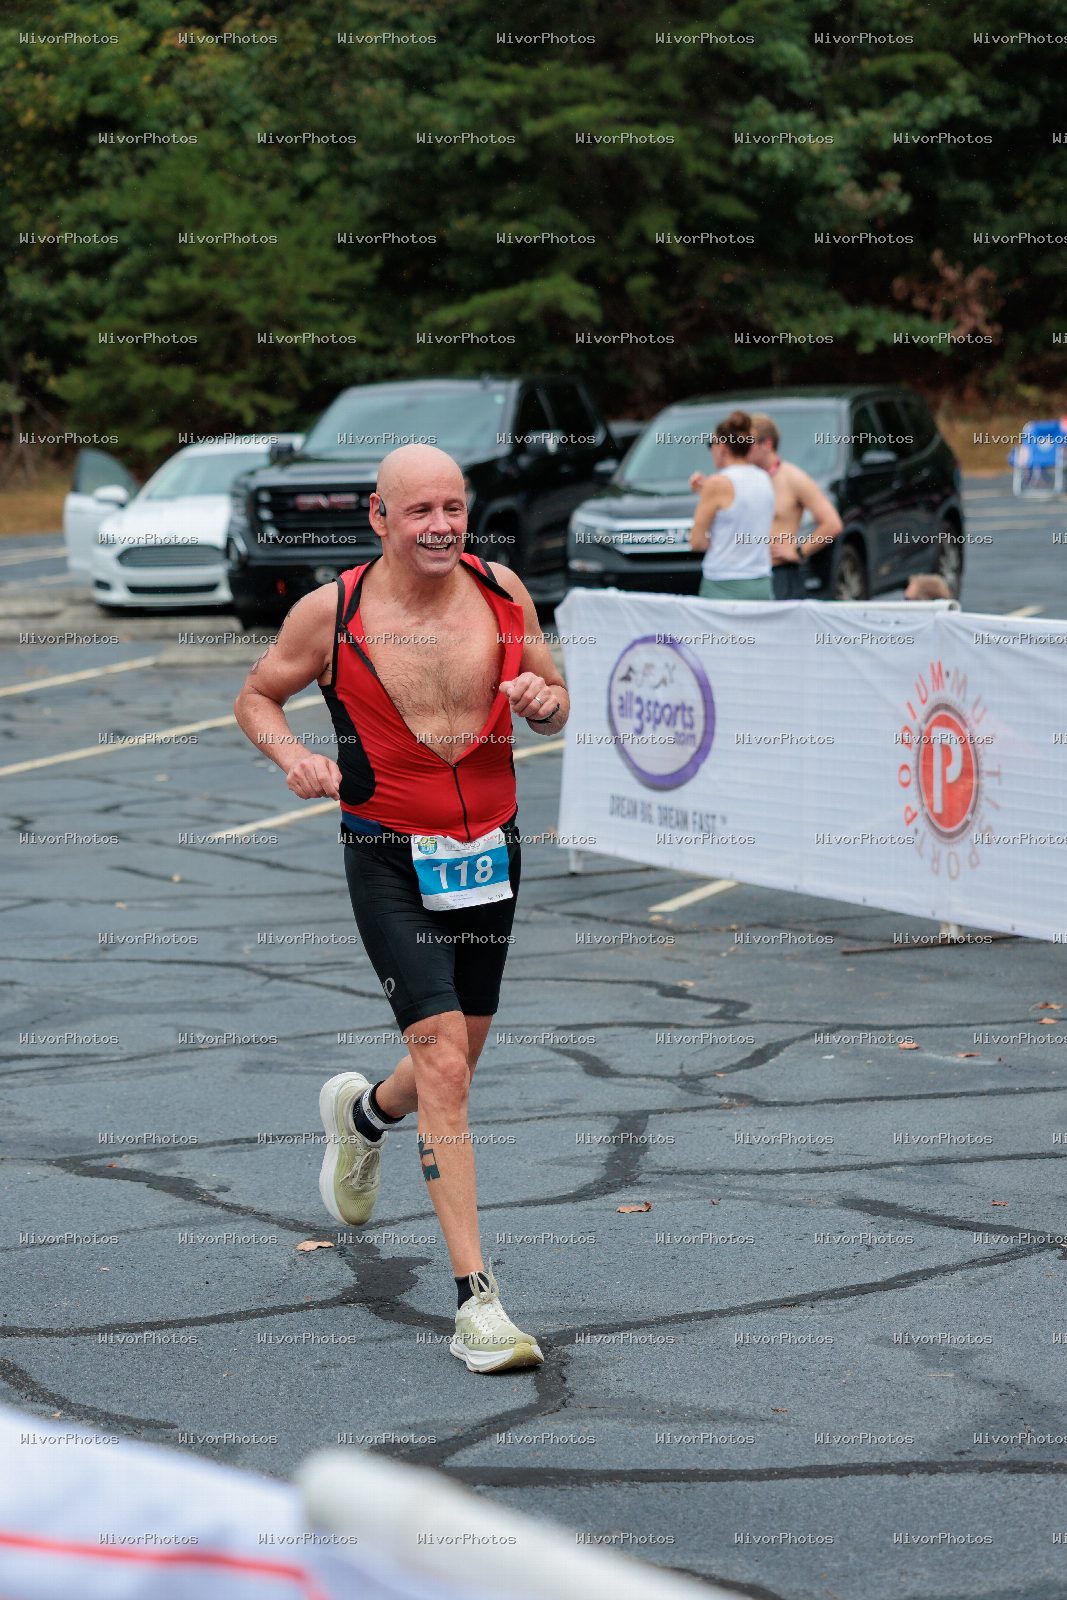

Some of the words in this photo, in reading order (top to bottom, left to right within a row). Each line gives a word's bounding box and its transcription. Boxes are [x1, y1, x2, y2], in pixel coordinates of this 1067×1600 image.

[618, 691, 695, 736] all3sports
[898, 659, 945, 827] PODIUM
[609, 794, 637, 820] DREAM
[657, 805, 688, 831] DREAM
[432, 855, 494, 889] 118
